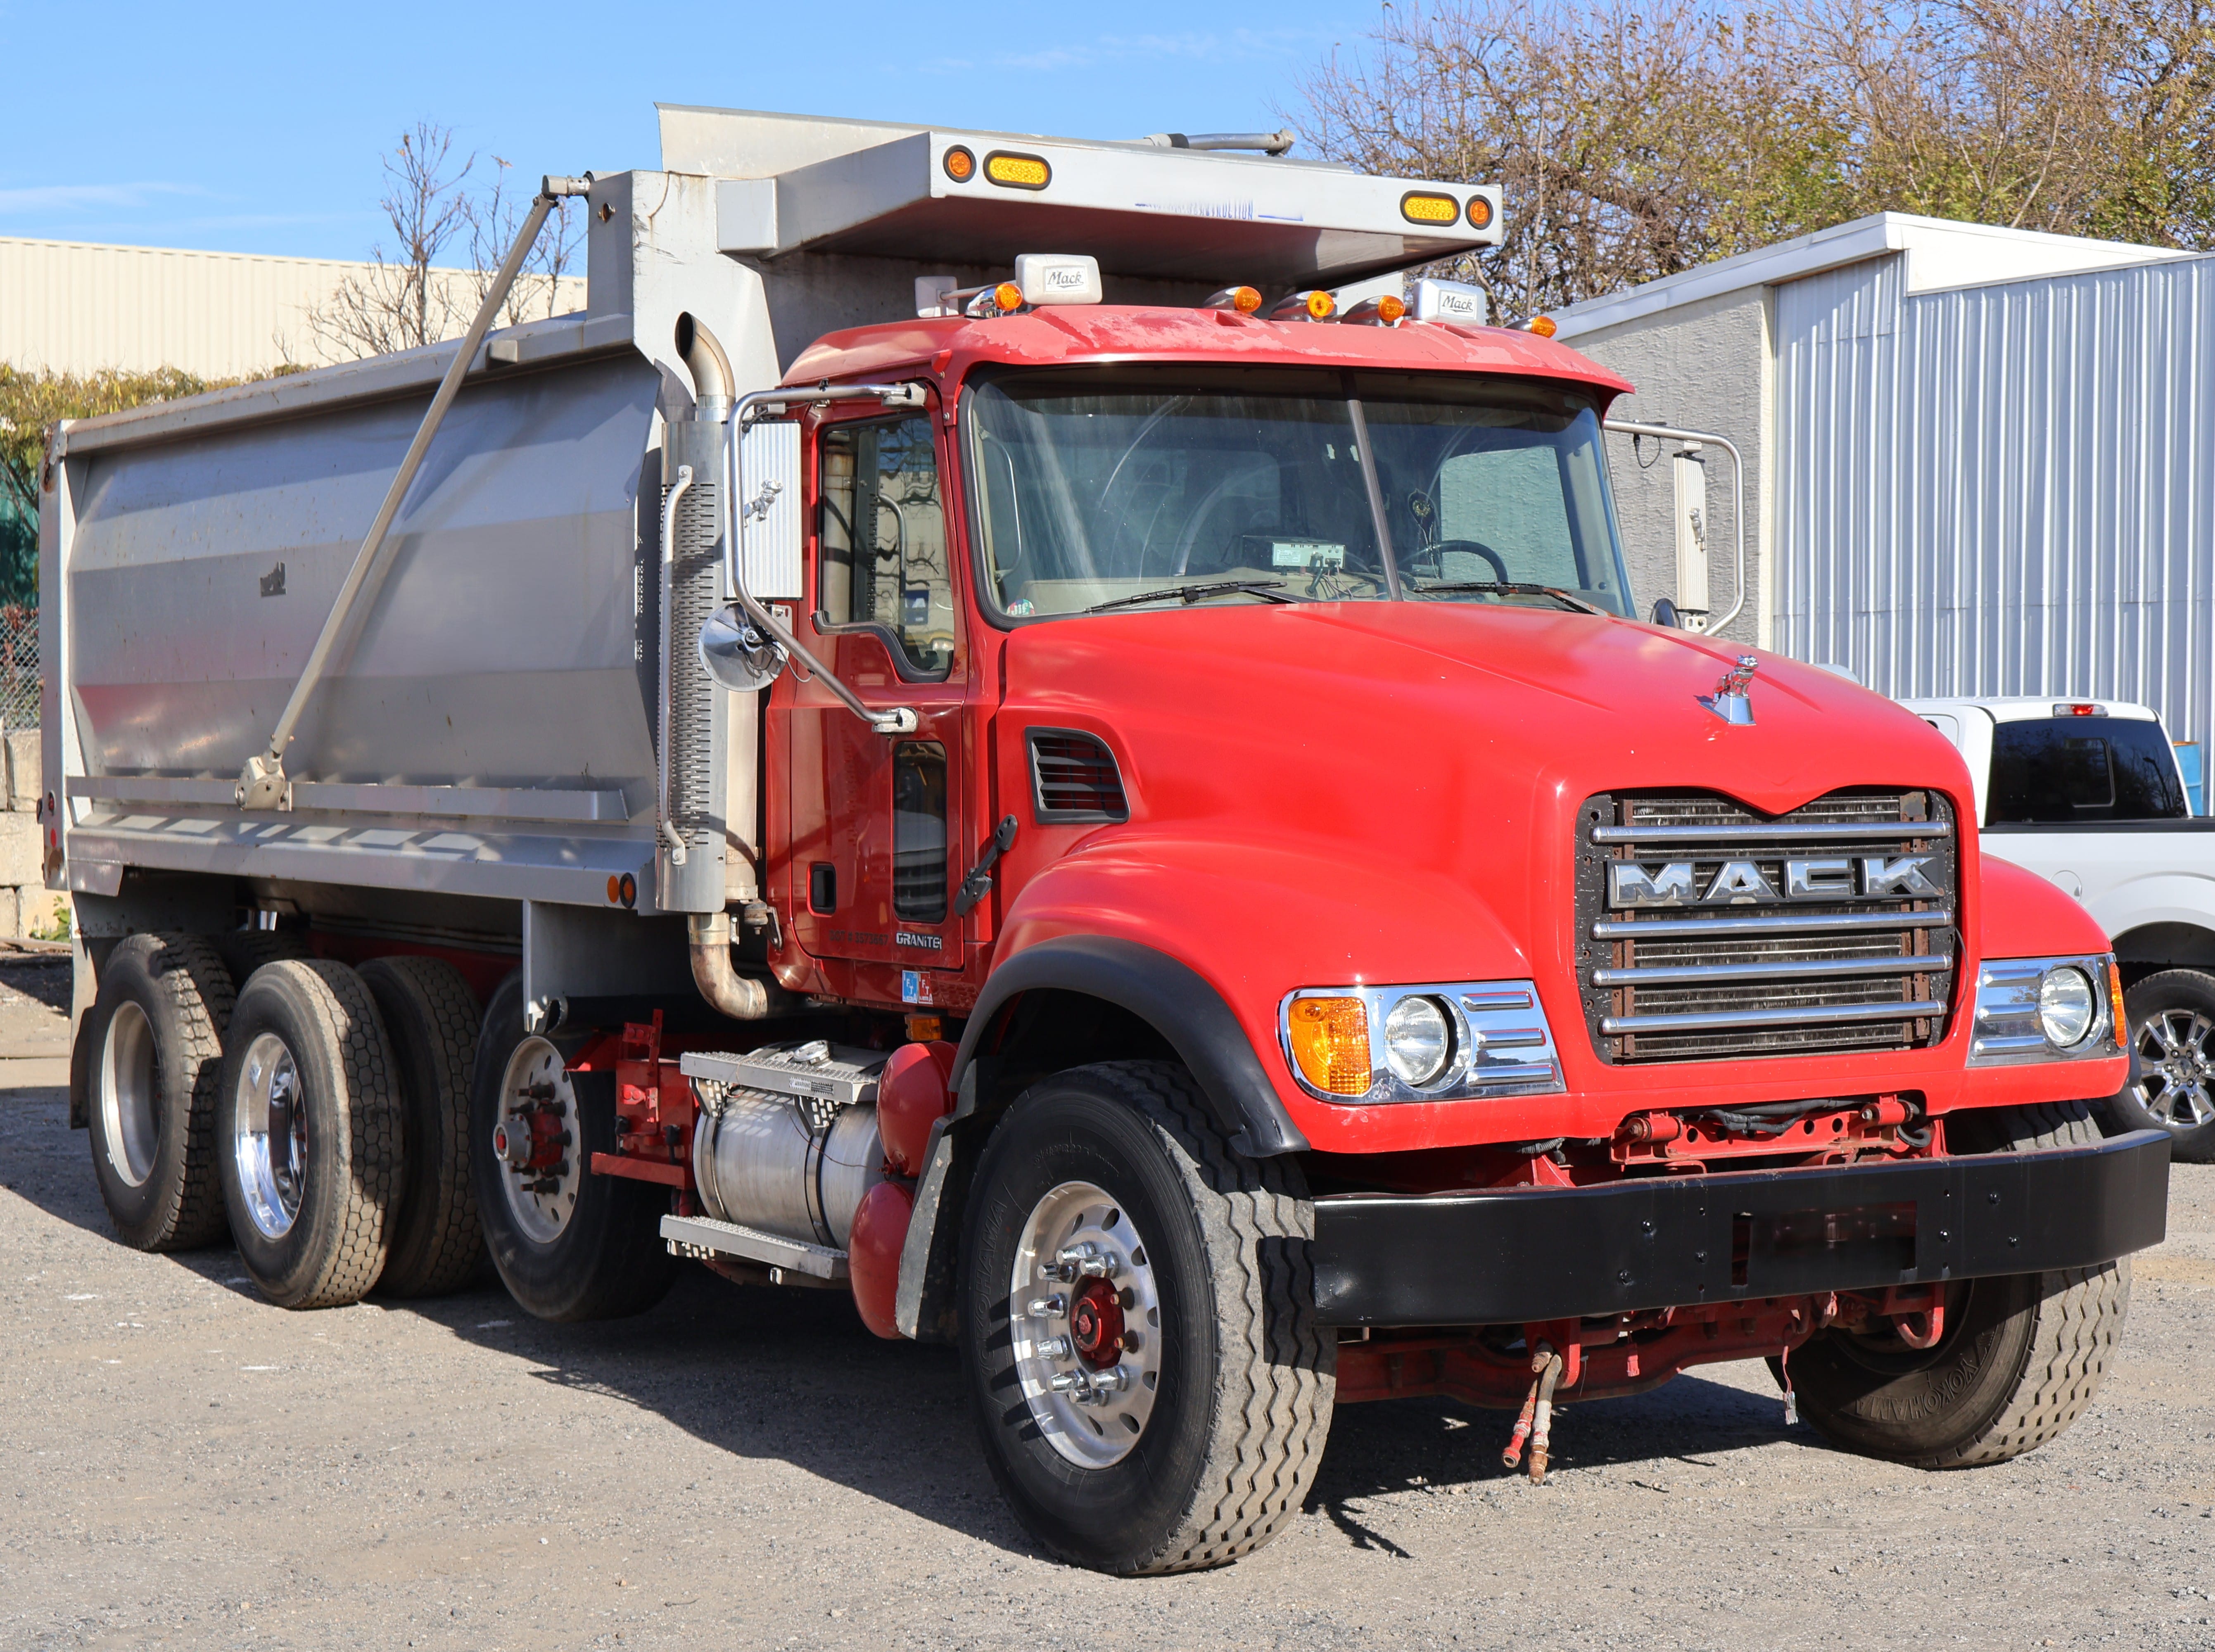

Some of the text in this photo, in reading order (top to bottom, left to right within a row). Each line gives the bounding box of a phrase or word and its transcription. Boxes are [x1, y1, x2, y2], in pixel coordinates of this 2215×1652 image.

[1047, 271, 1084, 288] Mack
[1441, 295, 1473, 313] Mack
[1614, 857, 1944, 902] MACK
[829, 930, 845, 941] DOT
[1855, 1358, 1978, 1421] YOKOHAMA
